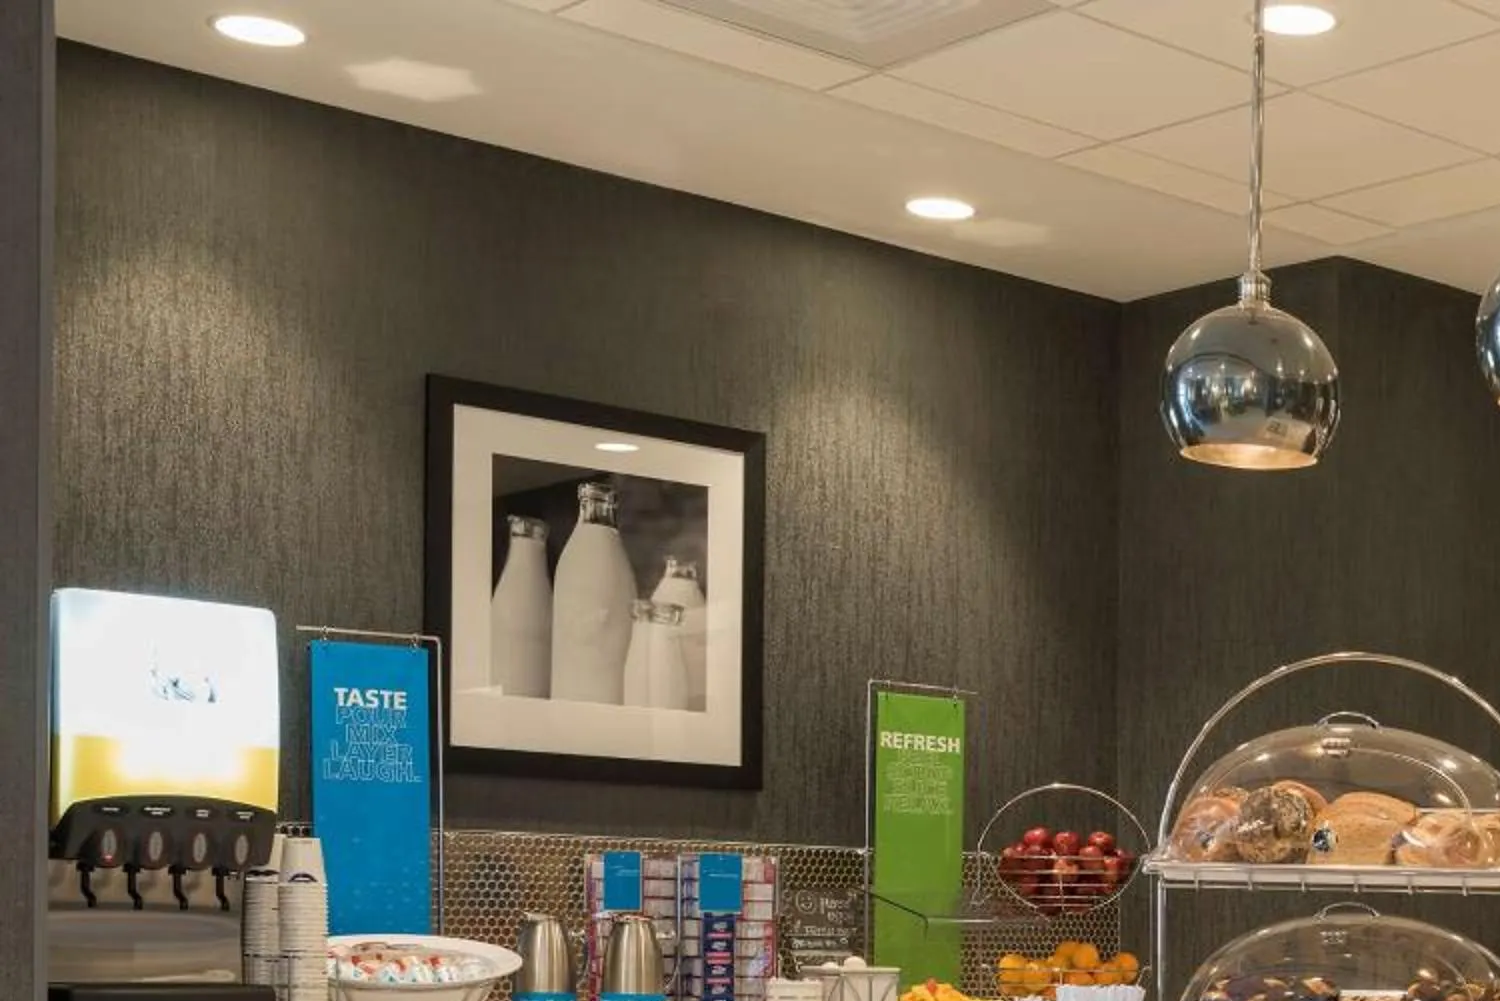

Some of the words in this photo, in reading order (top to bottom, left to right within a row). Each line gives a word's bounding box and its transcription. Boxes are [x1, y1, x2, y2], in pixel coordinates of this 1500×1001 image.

[333, 687, 407, 710] TASTE
[335, 705, 407, 729] POUR
[345, 723, 397, 745] MIX
[880, 731, 961, 753] REFRESH
[331, 740, 413, 763] LAYER
